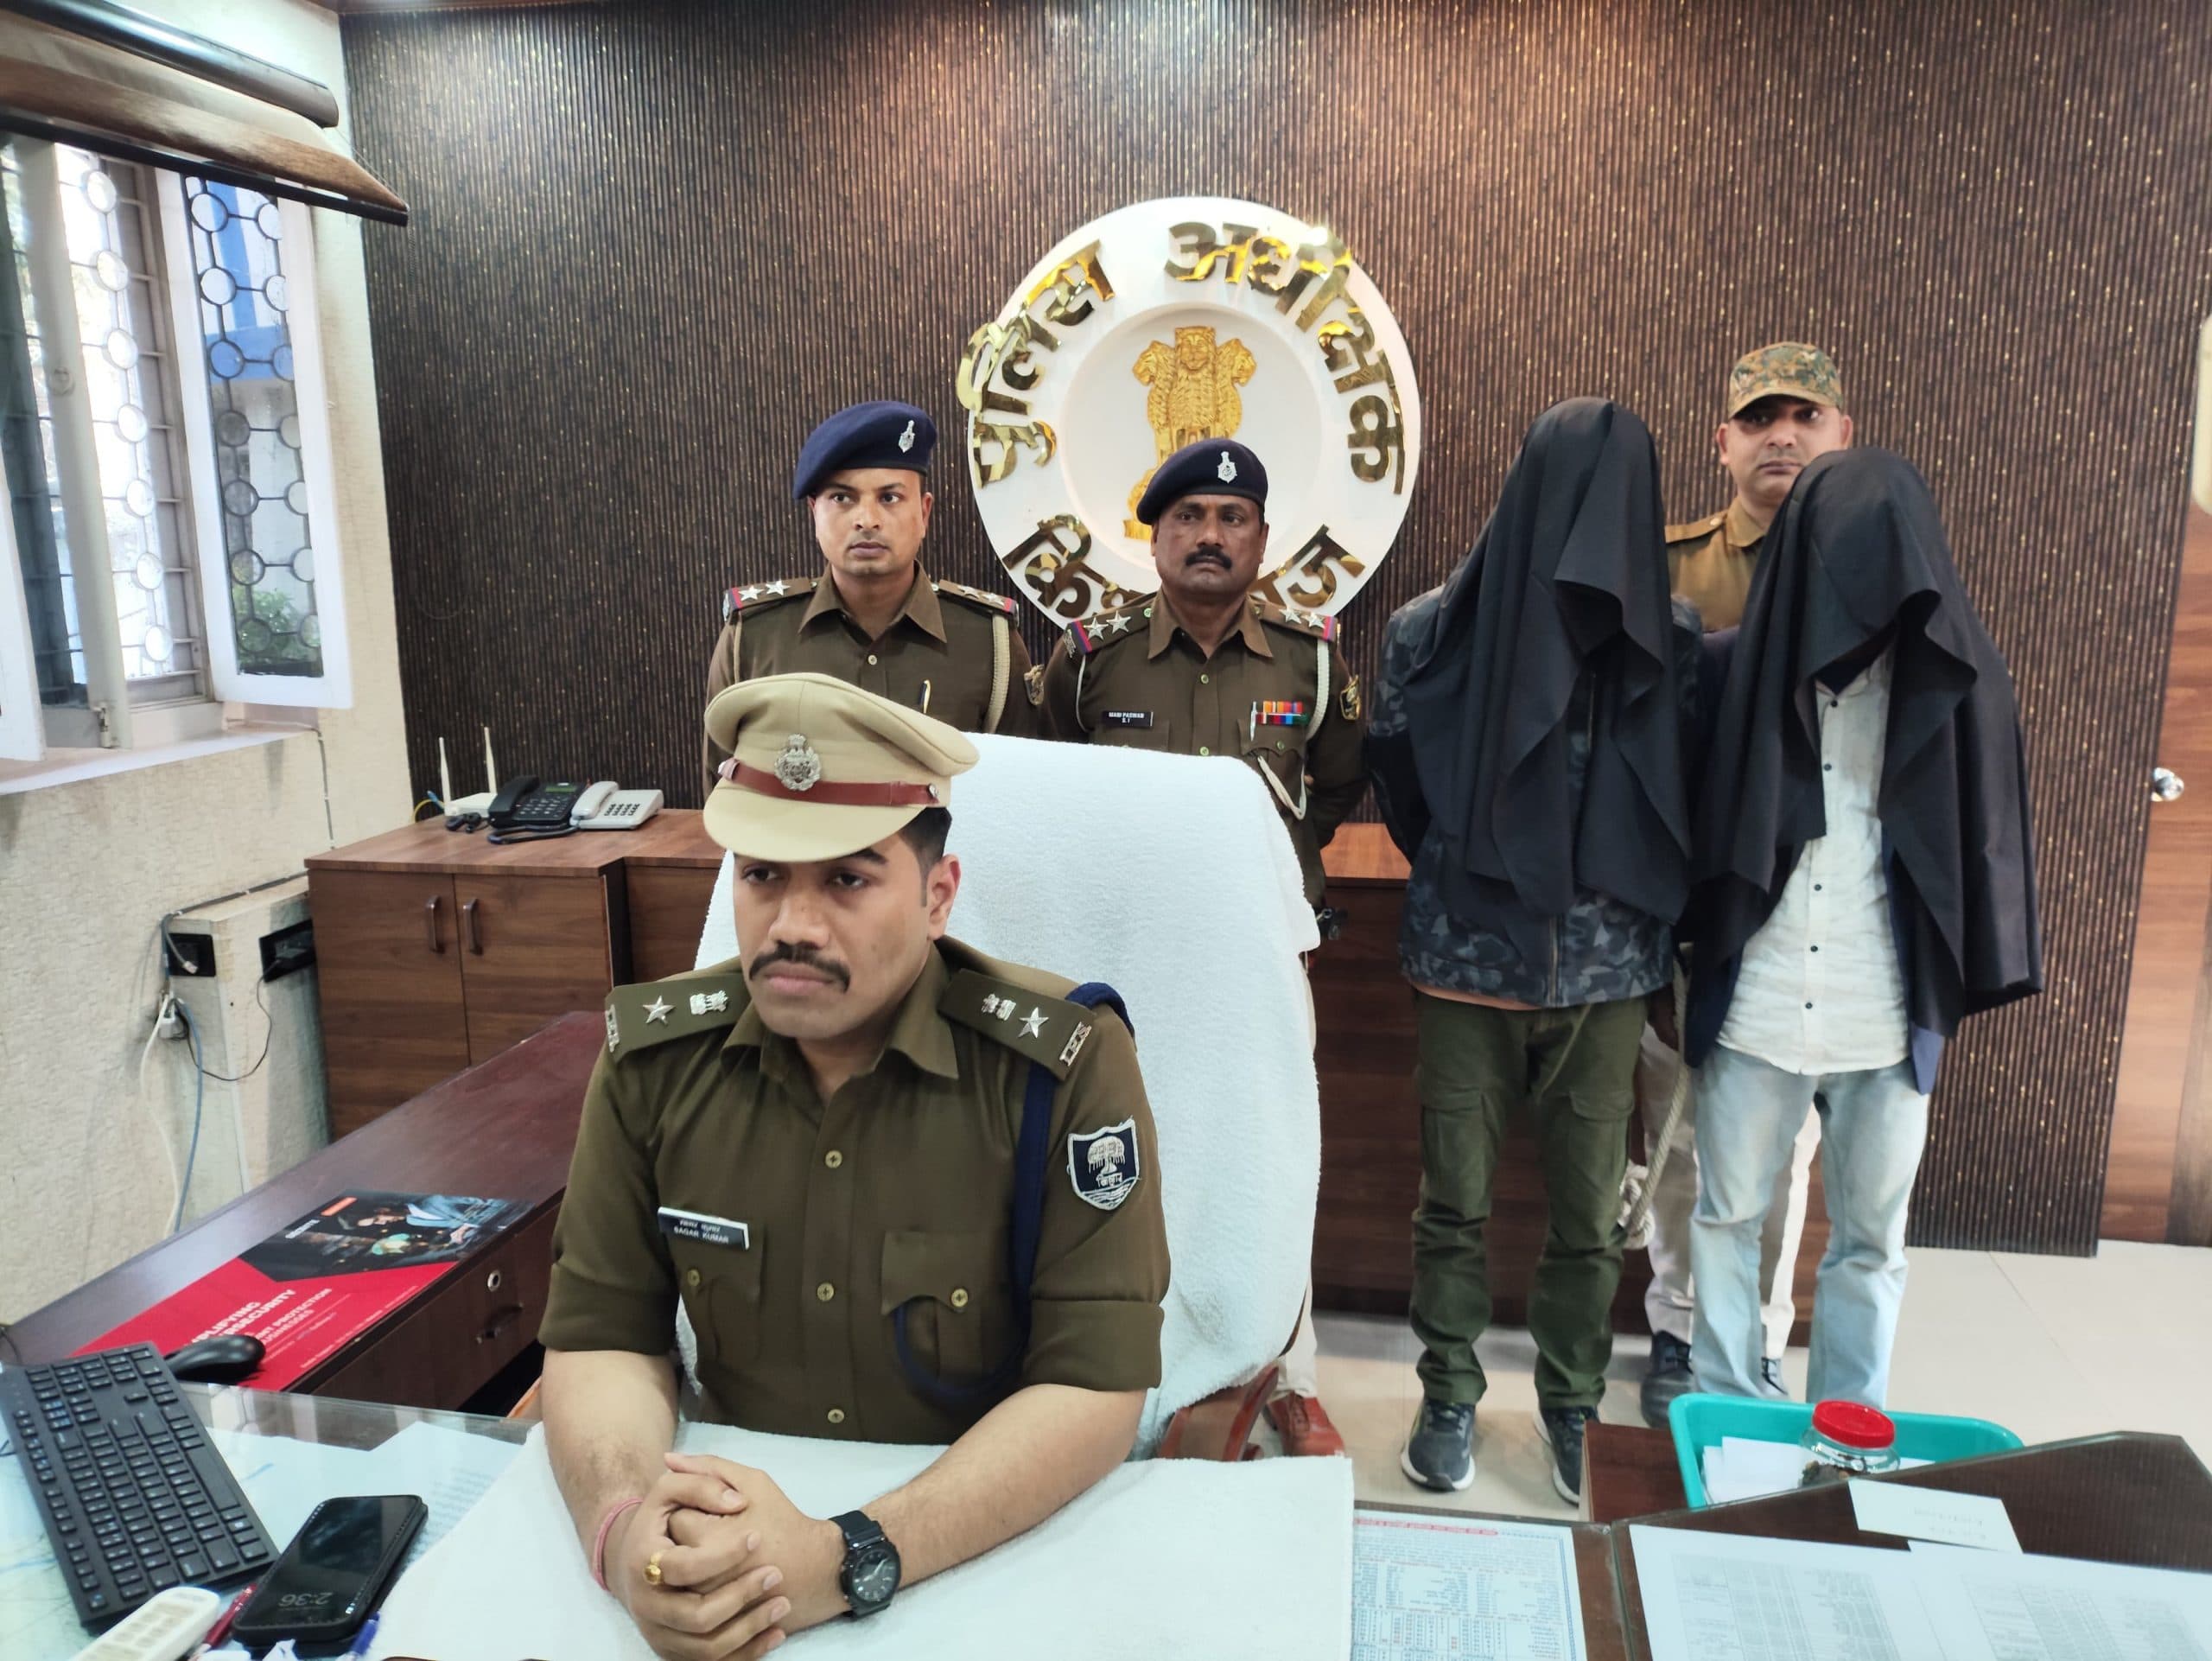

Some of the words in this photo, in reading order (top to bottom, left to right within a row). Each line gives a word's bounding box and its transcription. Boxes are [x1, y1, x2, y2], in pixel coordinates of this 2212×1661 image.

[957, 239, 1115, 487] पुलिस
[1164, 220, 1406, 495] अधीक्षक
[674, 1226, 699, 1238] SAGAR
[702, 1231, 729, 1243] KUMAR
